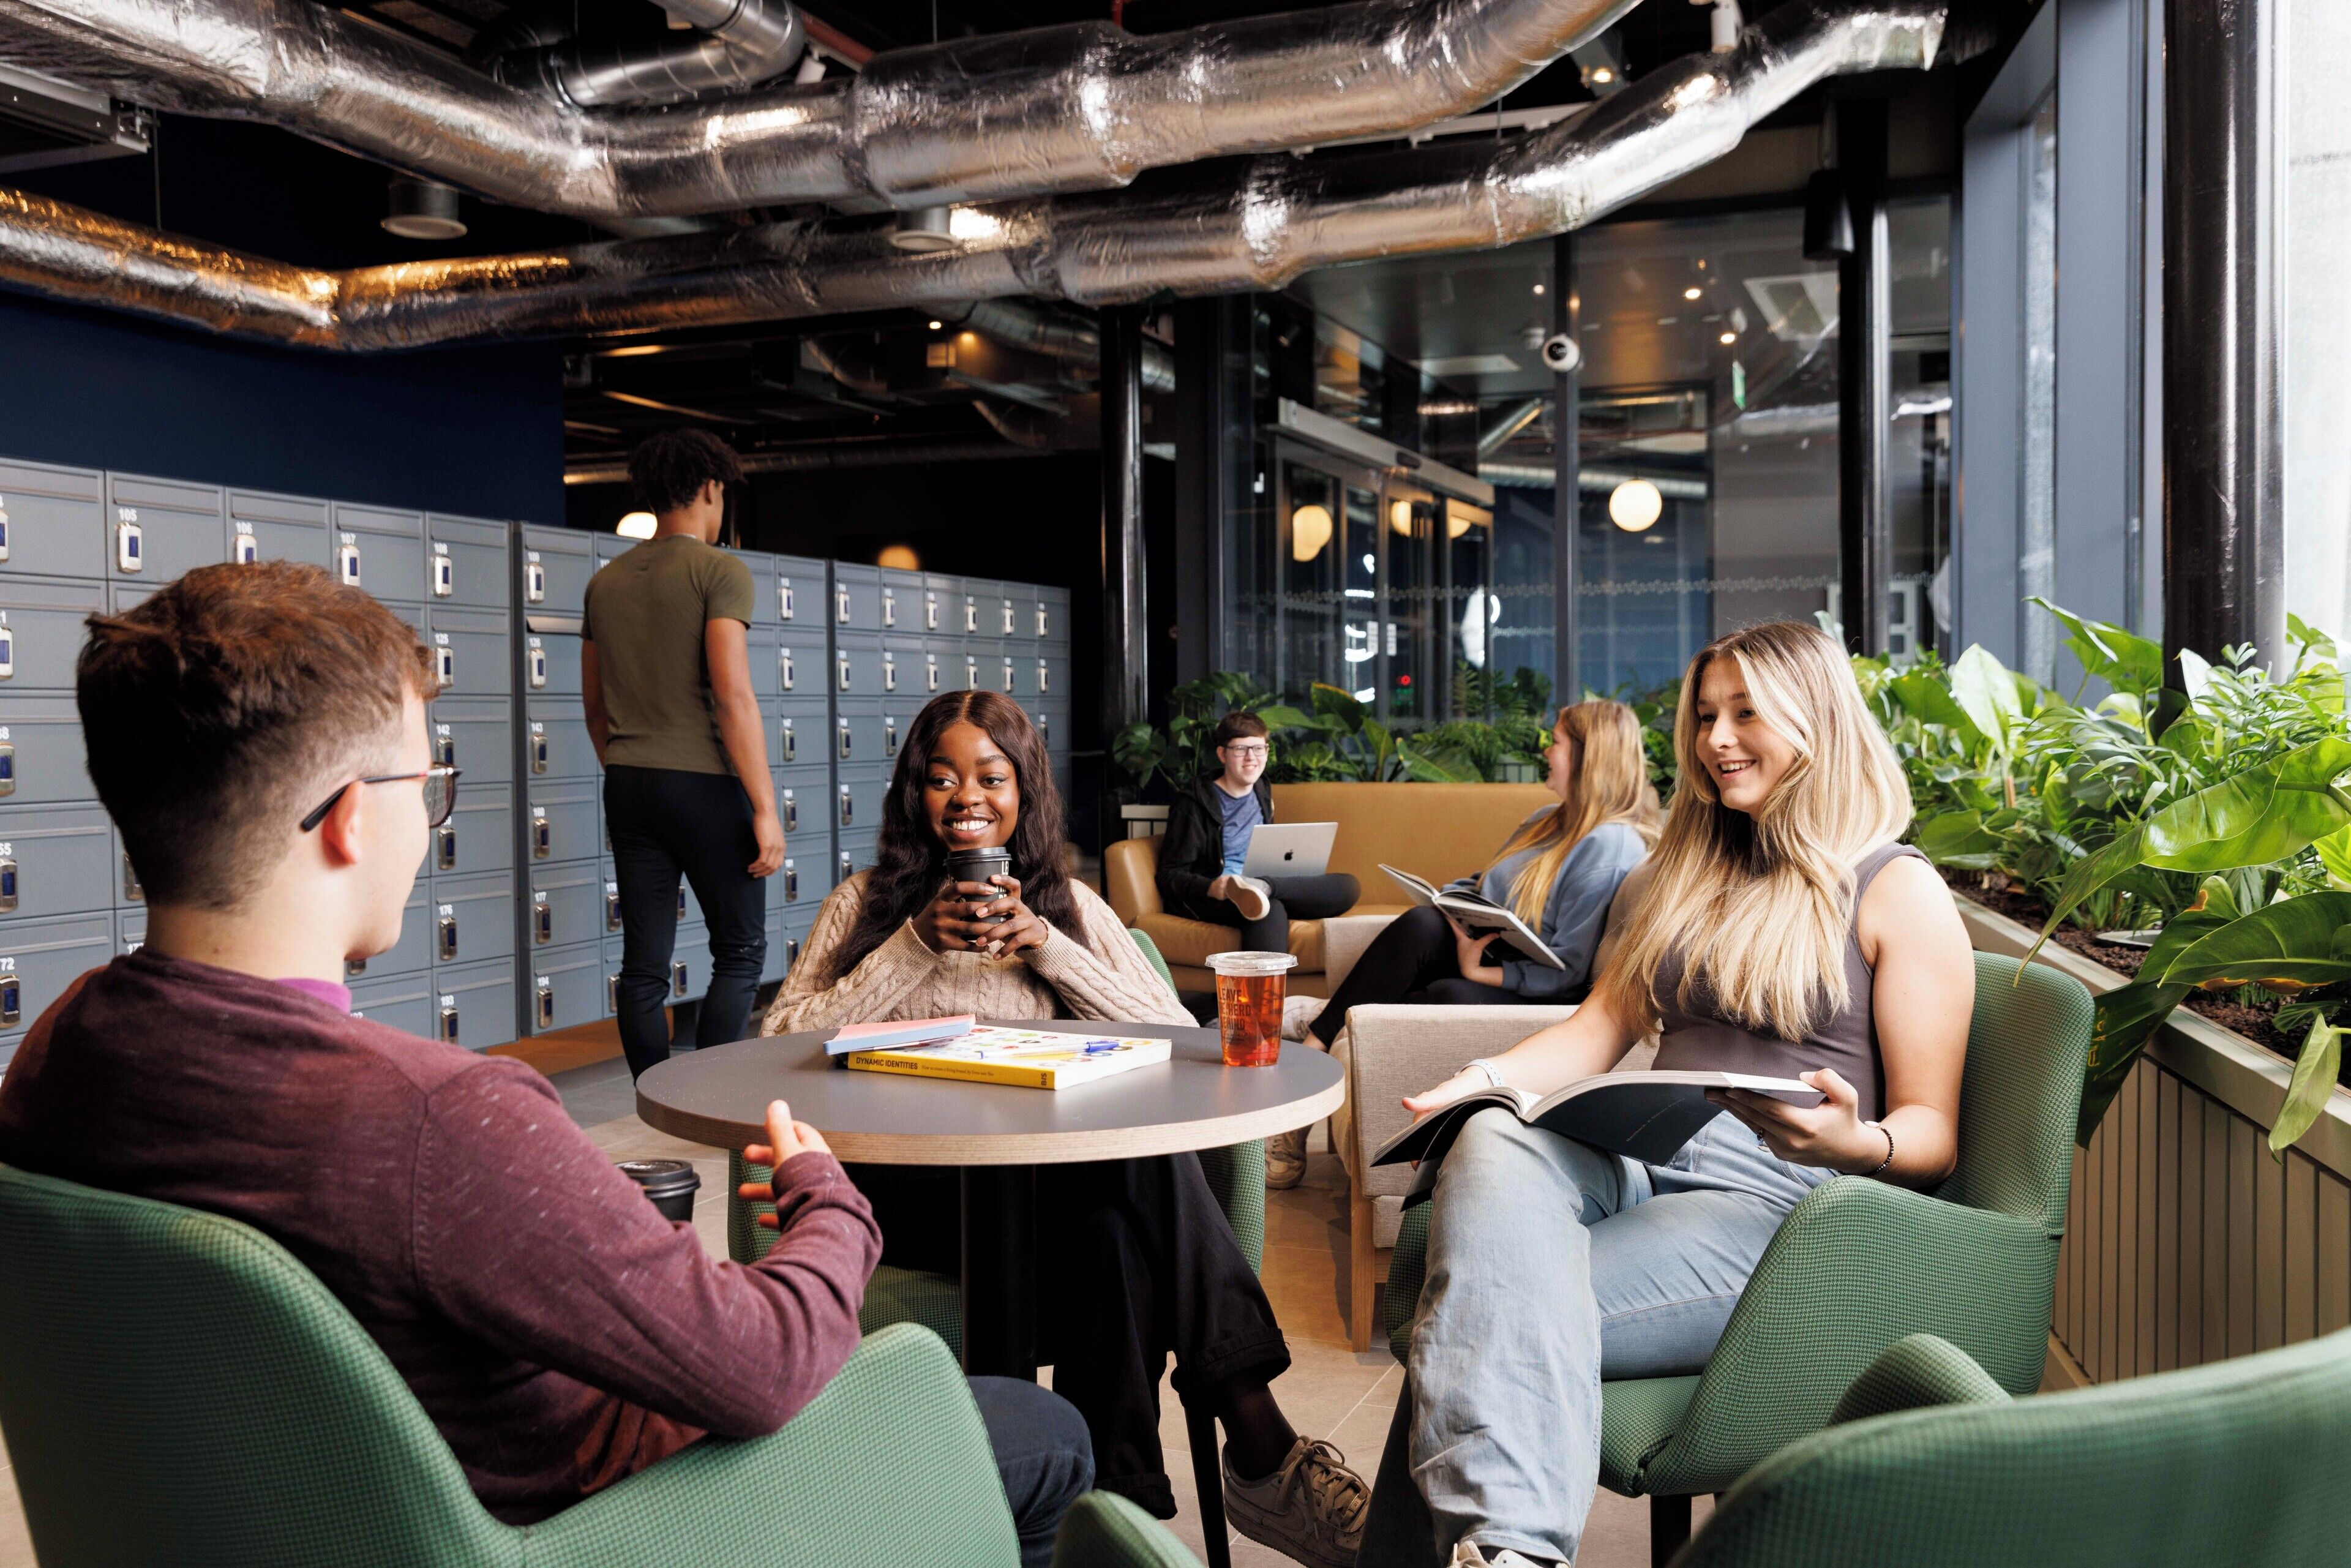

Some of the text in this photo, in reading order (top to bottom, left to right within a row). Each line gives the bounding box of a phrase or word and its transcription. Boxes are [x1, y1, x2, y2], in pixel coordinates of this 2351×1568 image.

[118, 508, 138, 522] 105
[127, 943, 143, 954] 17
[0, 958, 15, 970] 72
[856, 1057, 918, 1070] DYNAMIC IDENTITIES
